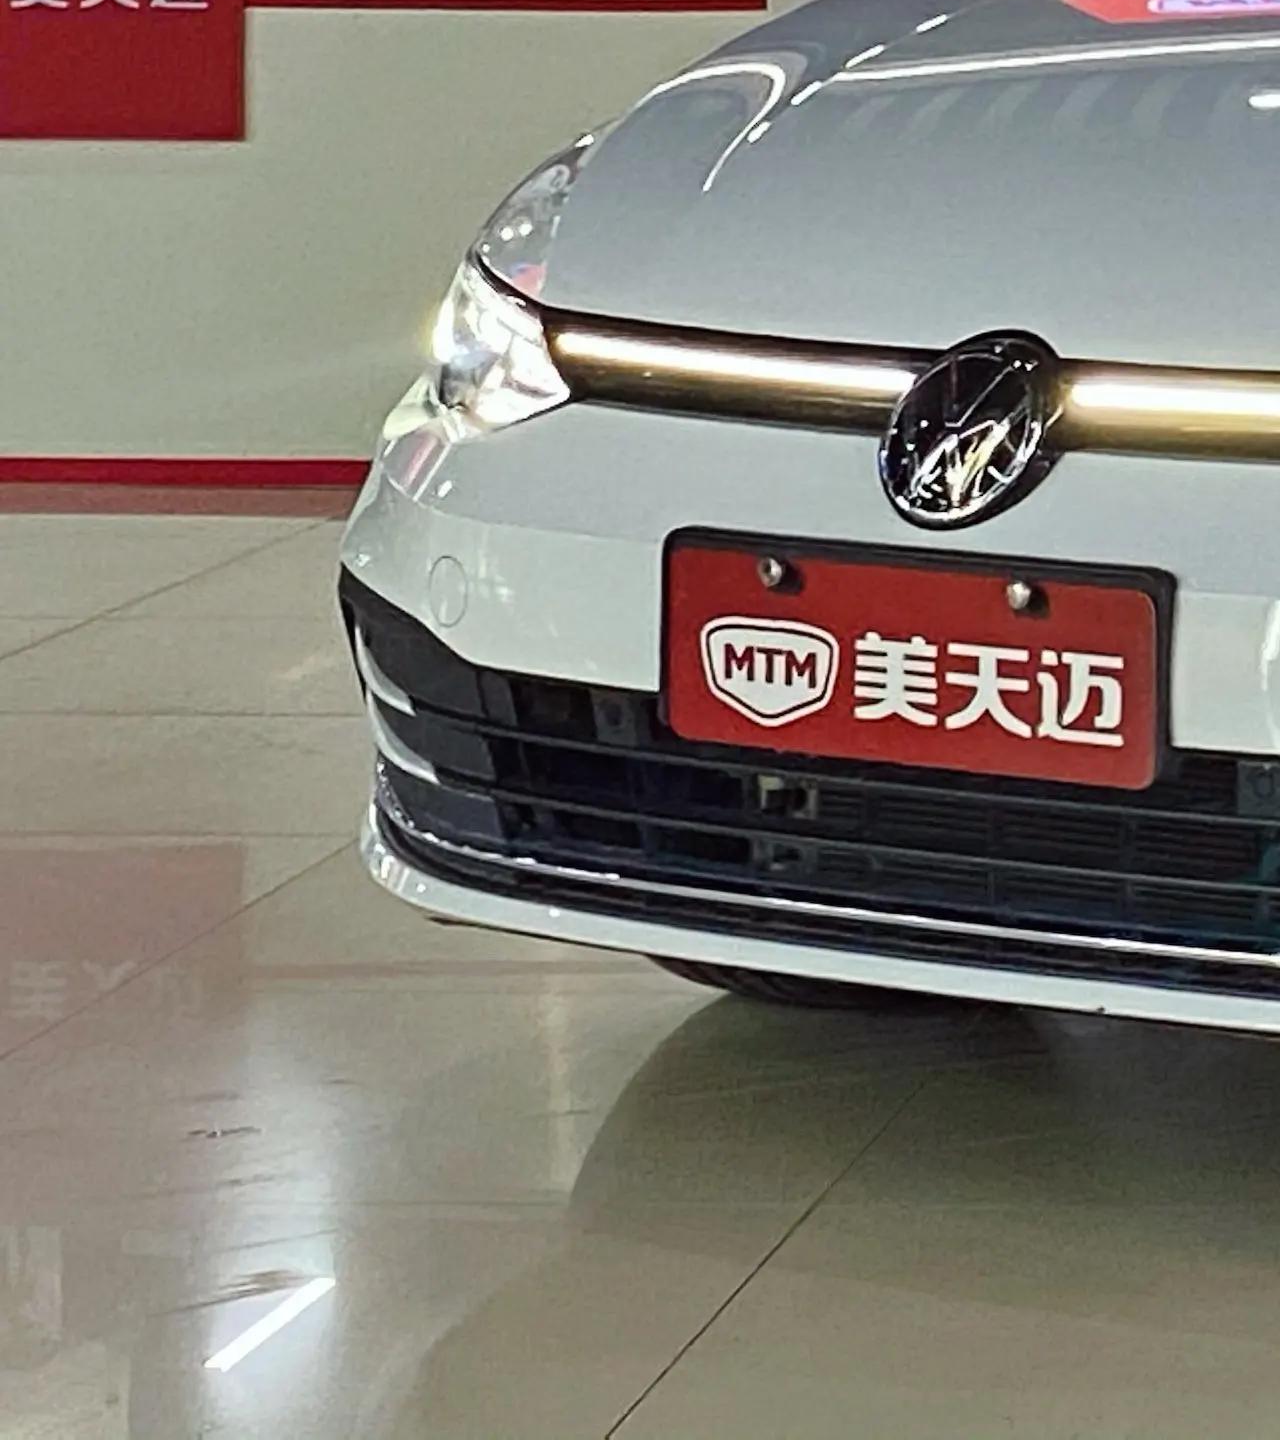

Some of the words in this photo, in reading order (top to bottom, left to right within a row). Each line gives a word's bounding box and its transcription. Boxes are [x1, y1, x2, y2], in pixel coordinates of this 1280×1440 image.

[723, 641, 818, 690] MTM
[852, 630, 1126, 748] 美天迈
